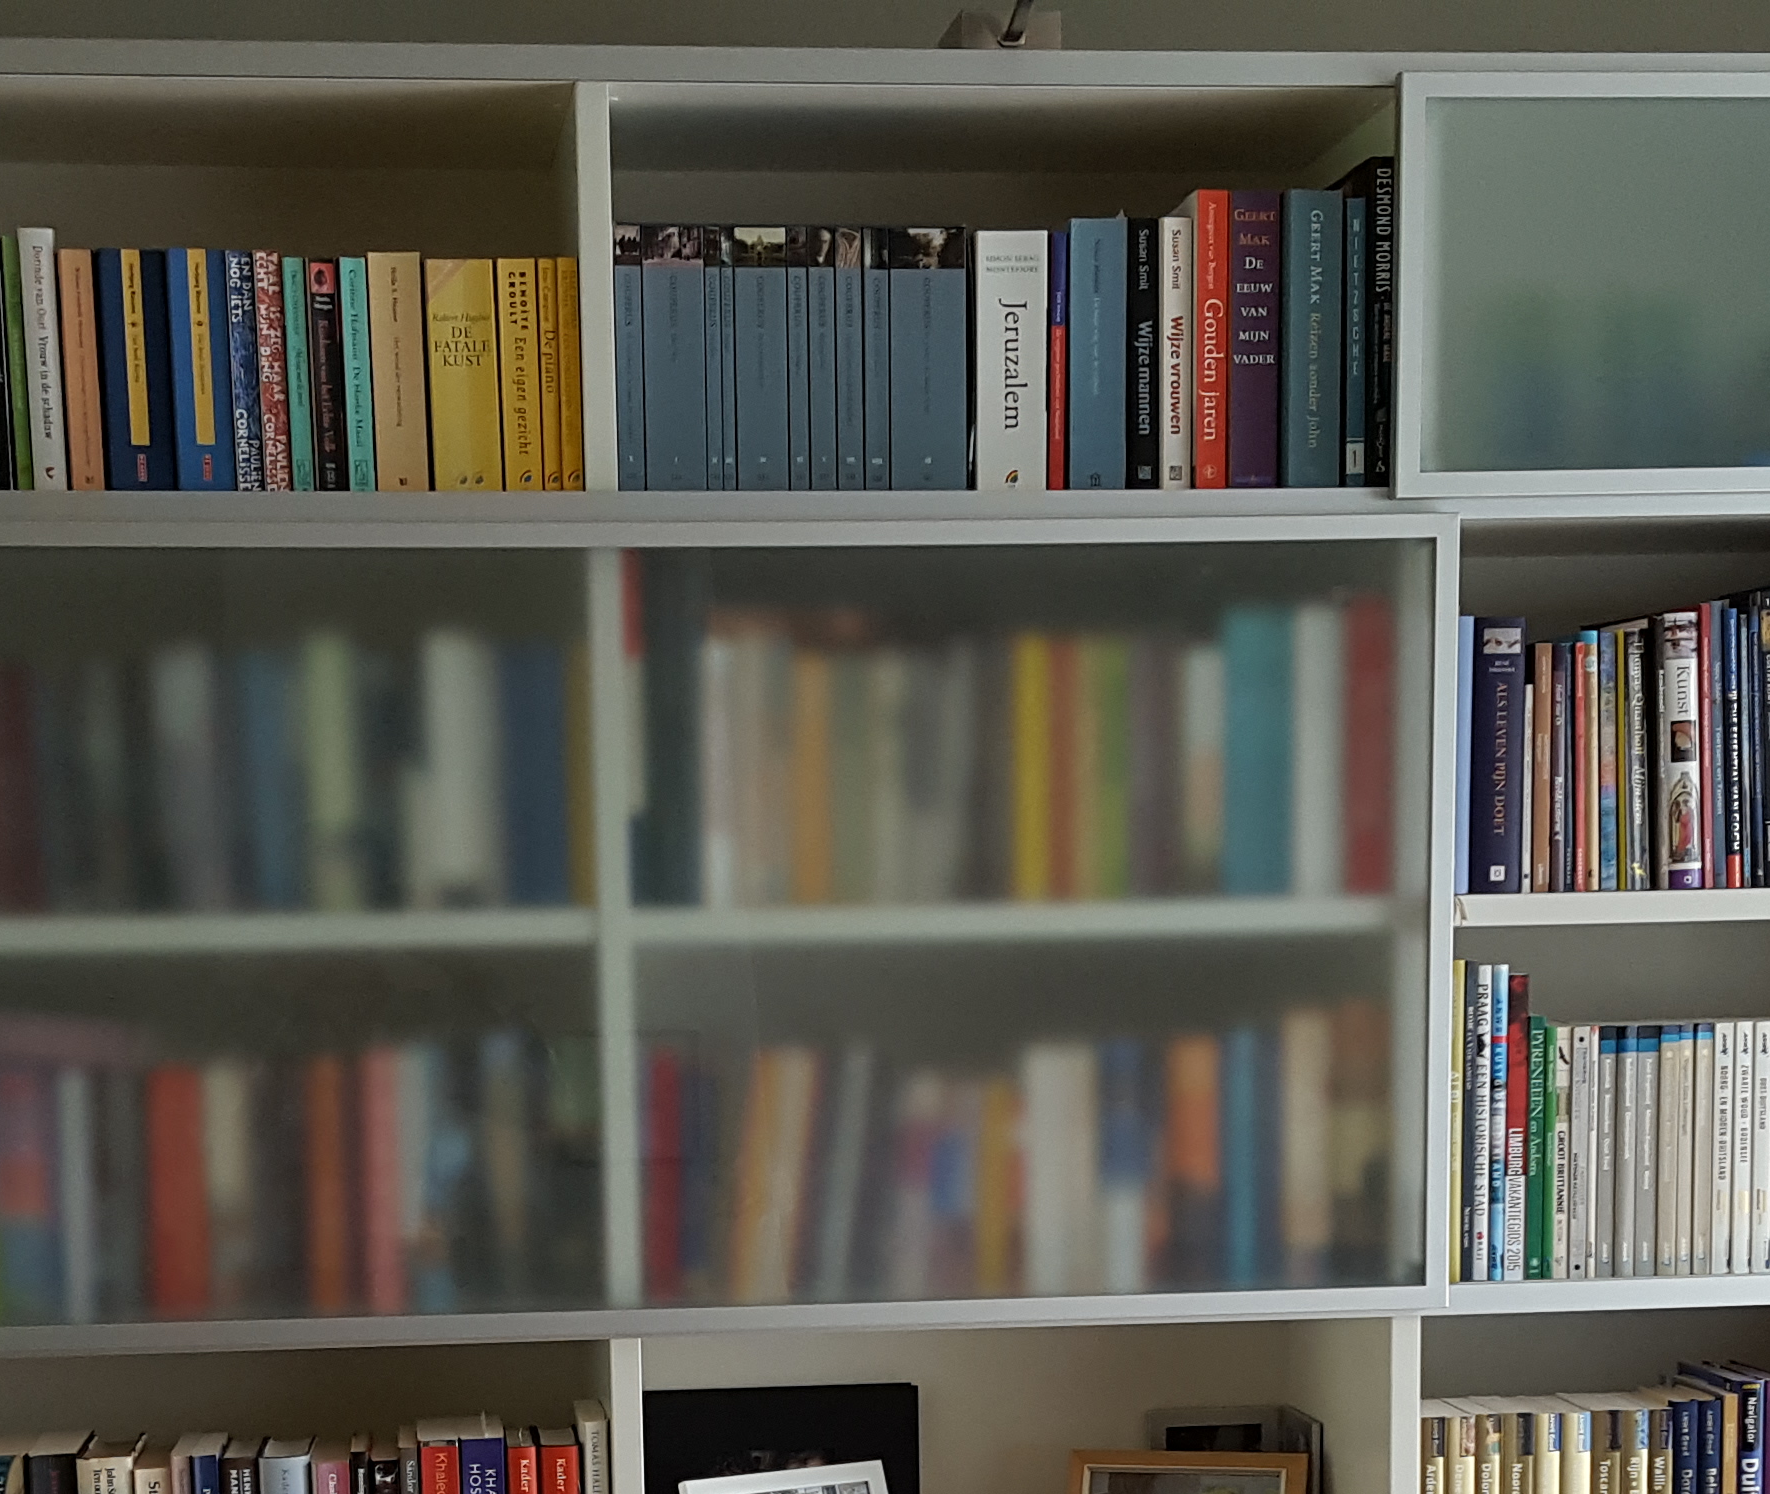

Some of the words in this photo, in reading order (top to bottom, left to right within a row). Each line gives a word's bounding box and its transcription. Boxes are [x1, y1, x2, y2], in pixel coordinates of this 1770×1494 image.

[1376, 169, 1390, 236] DESMOND
[1309, 210, 1323, 261] GEERT
[1309, 266, 1323, 304] MAK
[1376, 242, 1390, 292] MORRIS
[514, 337, 527, 362] Een
[1203, 298, 1223, 384] Gouden
[1309, 313, 1322, 359] Reizen
[512, 367, 530, 403] eigen
[997, 298, 1027, 430] Jeruzalem
[514, 408, 530, 455] gezicht
[1200, 389, 1219, 441] jaren
[1496, 683, 1508, 707] ALS
[1676, 666, 1691, 715] Kunst
[1496, 712, 1507, 759] LEVEN
[1478, 984, 1488, 1026] PRAAG
[1746, 1397, 1757, 1443] Navigator
[556, 1459, 567, 1491] Kader
